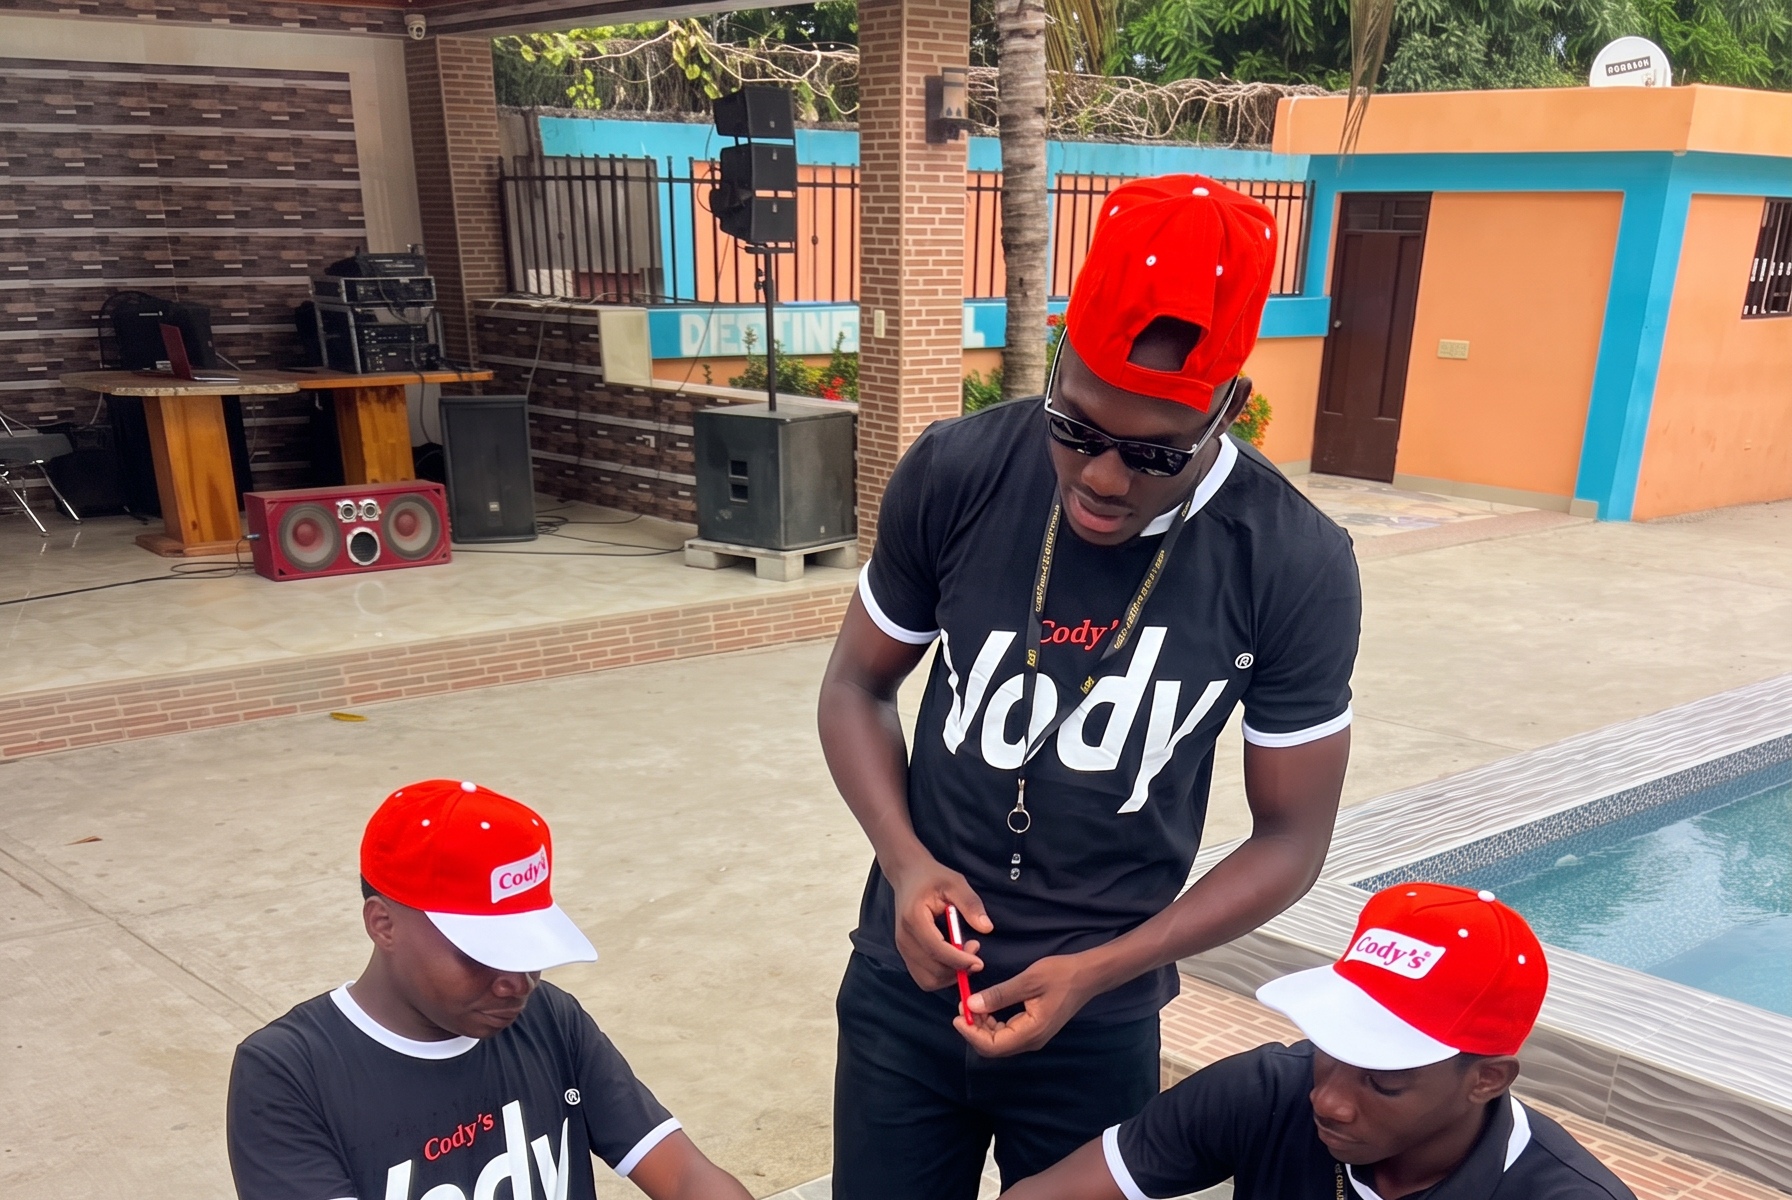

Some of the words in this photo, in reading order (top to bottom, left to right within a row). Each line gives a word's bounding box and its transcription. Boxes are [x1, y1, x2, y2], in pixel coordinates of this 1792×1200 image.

[1039, 619, 1119, 651] Cody'
[940, 626, 1229, 814] Vody
[1355, 936, 1426, 969] Cody's
[423, 1112, 495, 1161] Cody's
